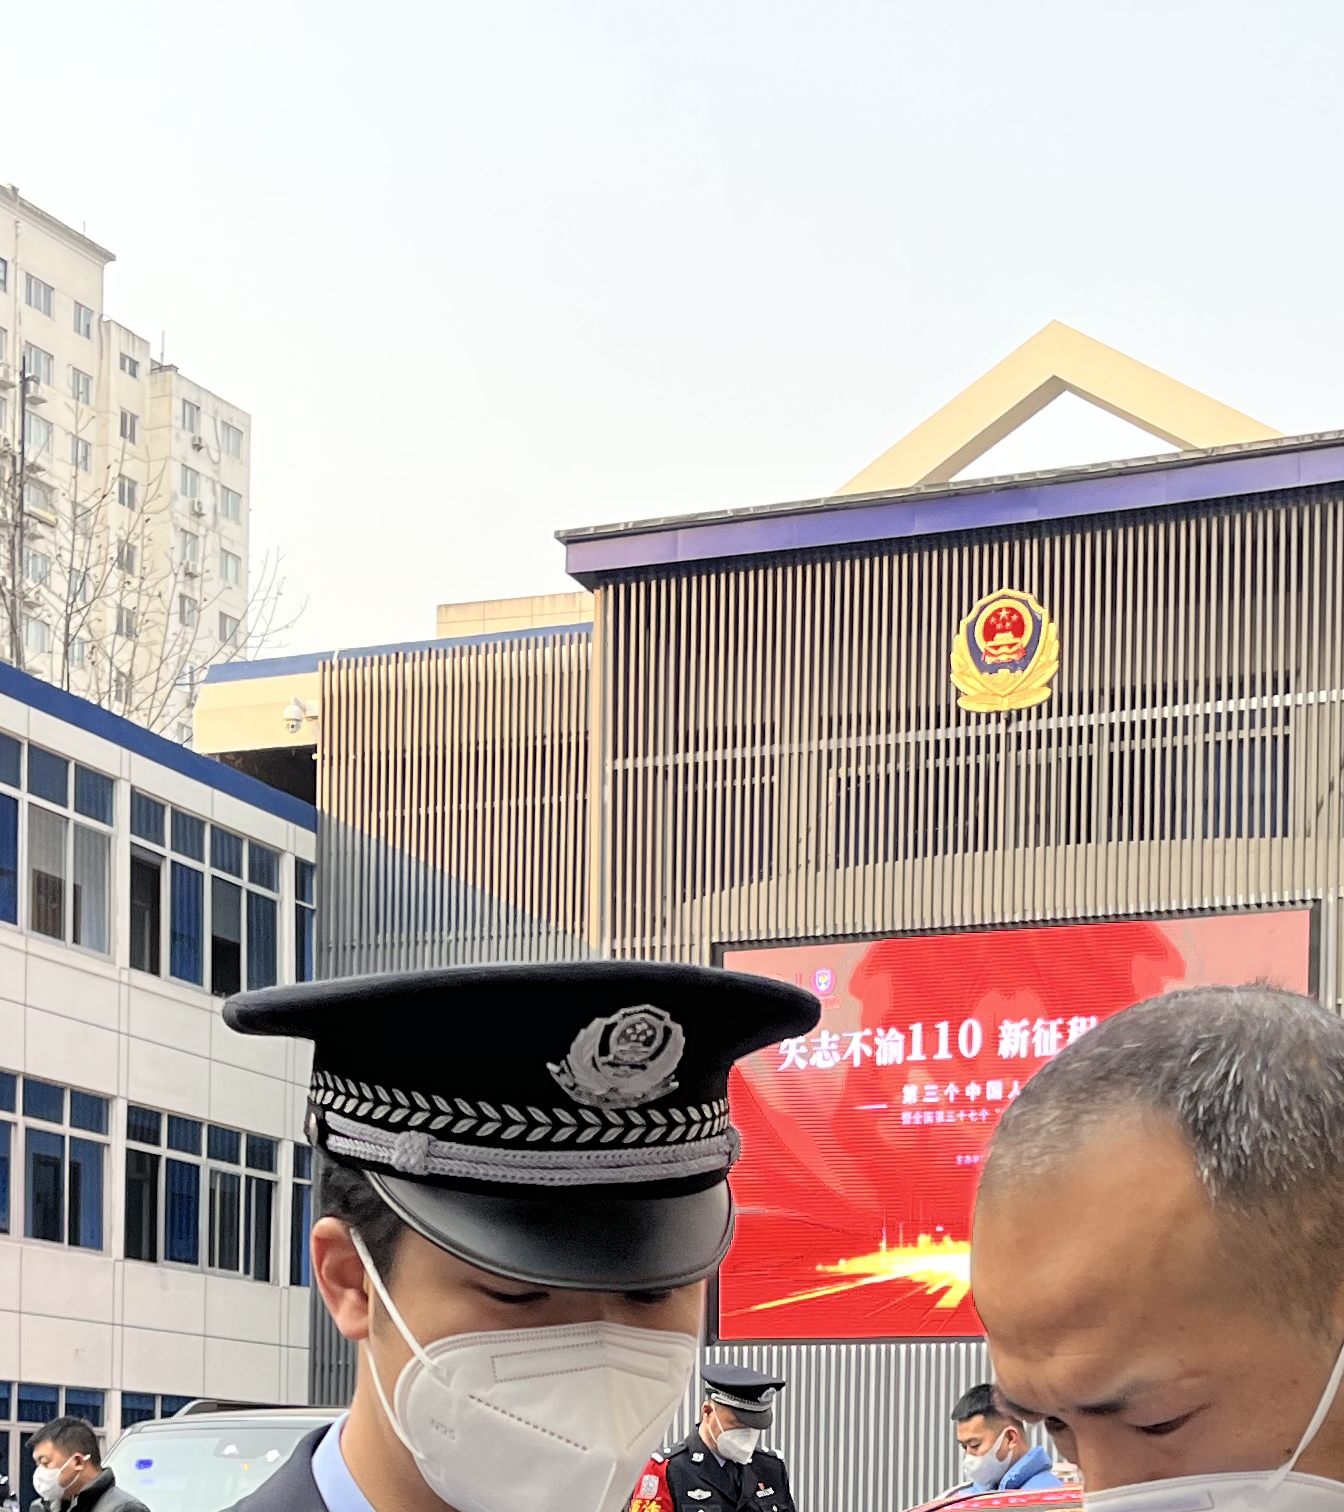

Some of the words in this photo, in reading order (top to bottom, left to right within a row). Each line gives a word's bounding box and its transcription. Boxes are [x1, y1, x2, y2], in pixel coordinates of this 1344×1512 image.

[777, 1018, 983, 1072] 矢志不渝110
[902, 1081, 1021, 1105] 第三个中国人
